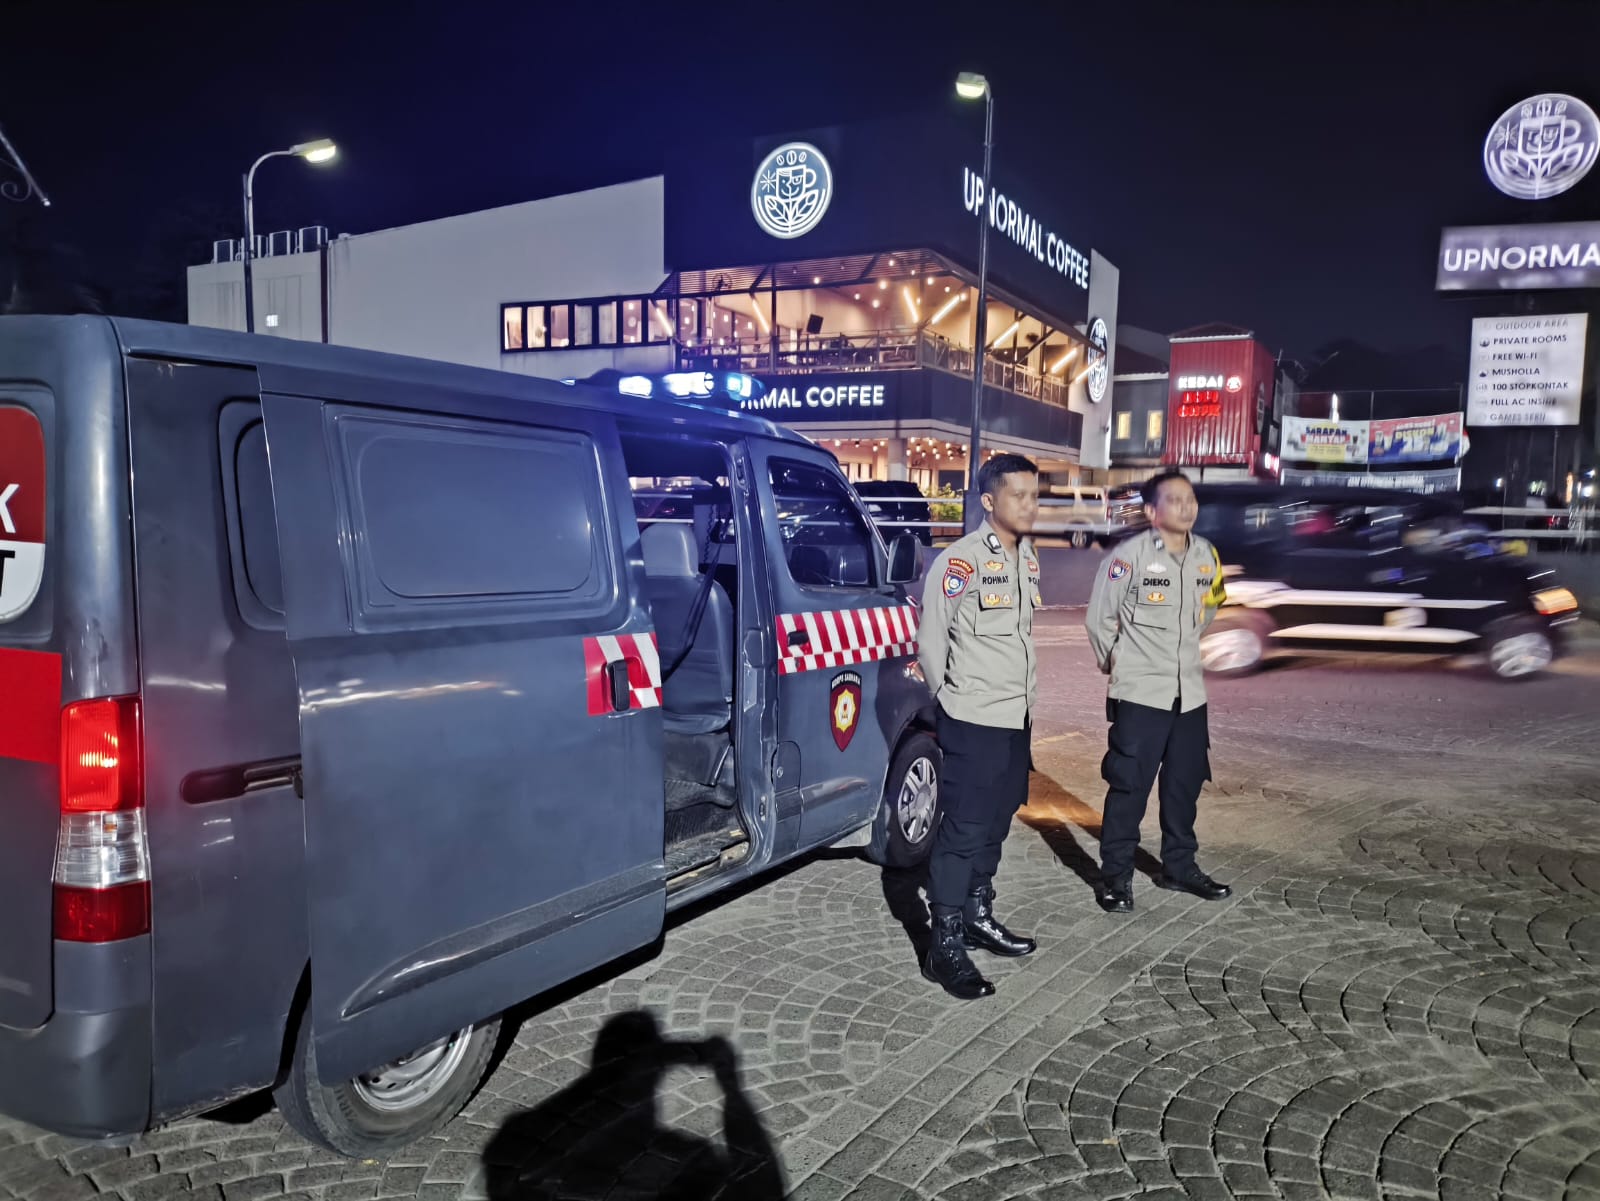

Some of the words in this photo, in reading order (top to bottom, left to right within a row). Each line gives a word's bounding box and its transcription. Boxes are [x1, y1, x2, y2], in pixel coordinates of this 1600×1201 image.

[1046, 231, 1090, 290] COFFEE
[1493, 336, 1530, 345] PRIVATE
[1532, 334, 1567, 343] ROOMS
[1492, 353, 1513, 361] FREE
[1515, 352, 1538, 360] WI-FI
[1492, 367, 1540, 376] MUSHOLLA
[1178, 375, 1224, 389] KEDAI
[1492, 383, 1508, 391] 100
[1509, 382, 1569, 391] STOPKONTAK
[805, 385, 885, 408] COFFEE
[1490, 398, 1509, 406] FULL
[1511, 398, 1525, 406] AC
[982, 575, 1009, 585] ROHMAT
[1142, 578, 1171, 587] DIEKO
